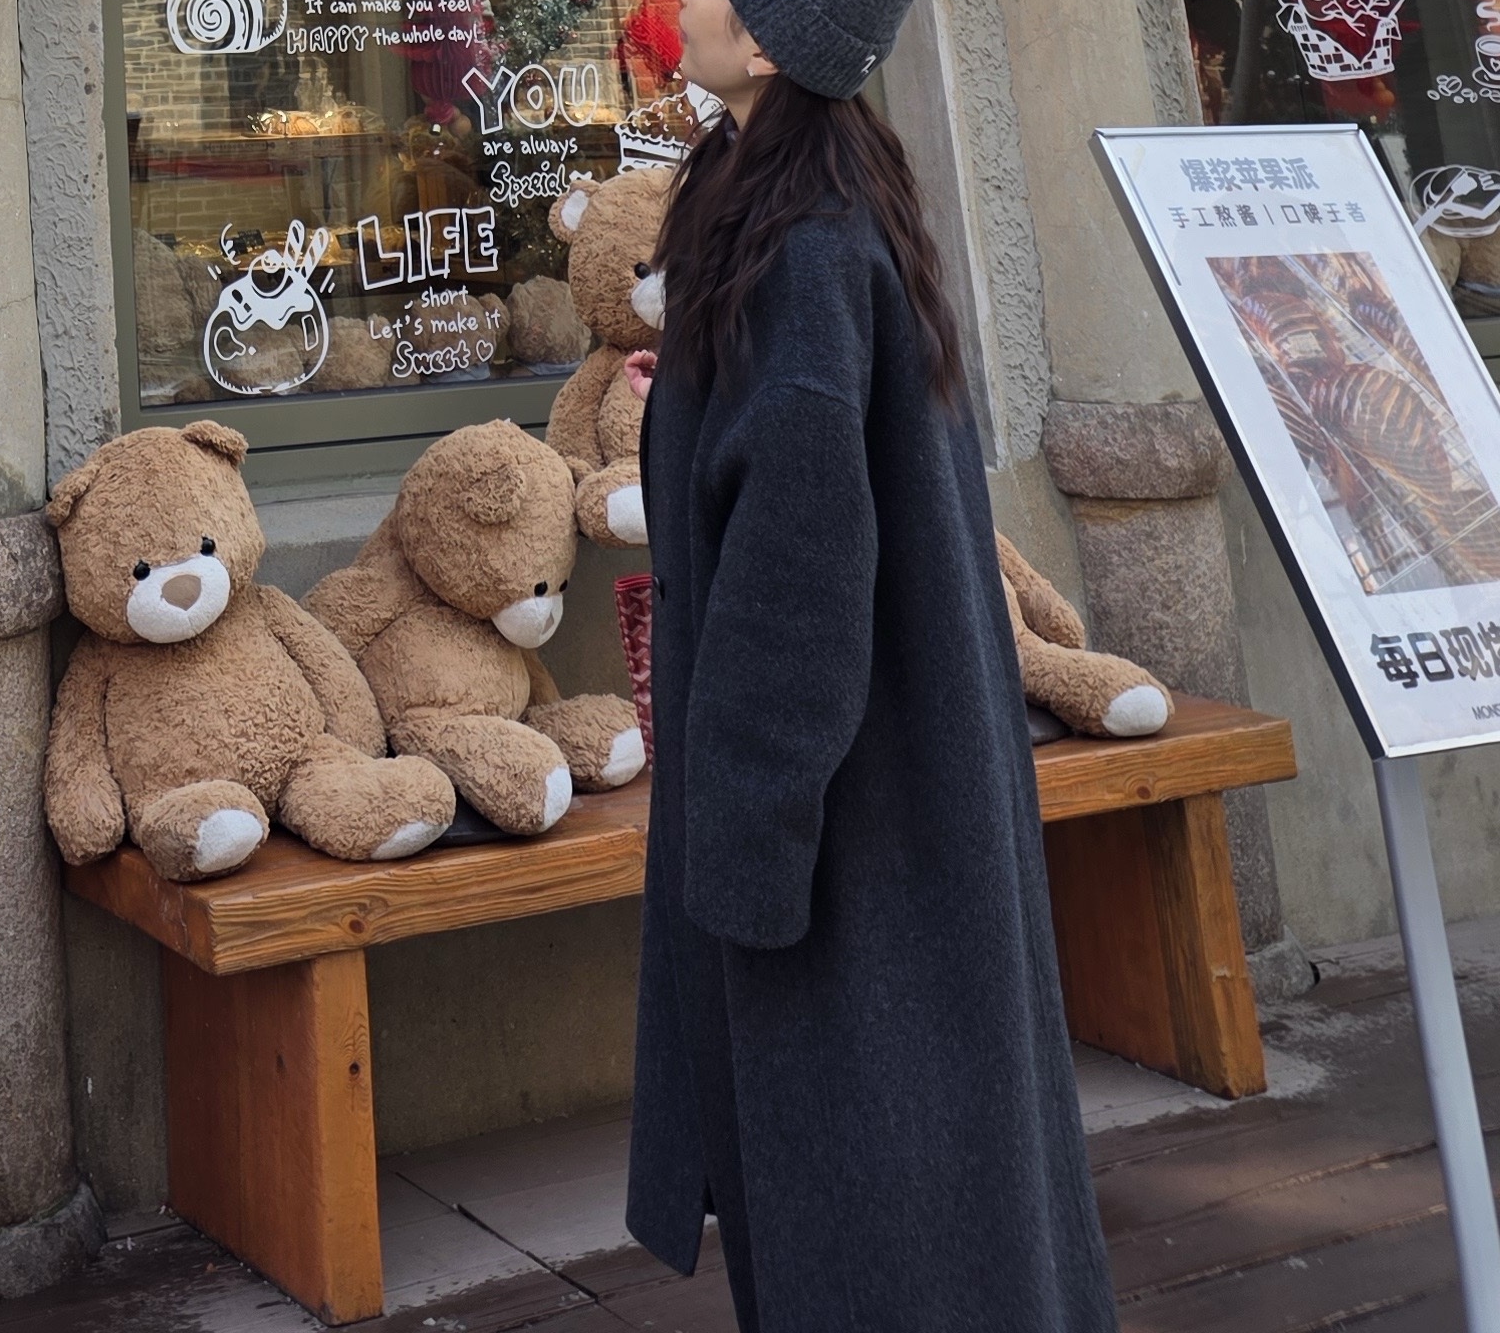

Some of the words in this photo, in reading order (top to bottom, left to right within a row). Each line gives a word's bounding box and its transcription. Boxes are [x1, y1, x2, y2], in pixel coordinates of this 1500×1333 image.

[330, 0, 357, 14] can
[406, 1, 434, 20] you
[287, 24, 370, 55] HAPPY
[372, 26, 400, 45] the
[403, 23, 445, 43] whole
[448, 23, 482, 49] day!
[461, 64, 600, 135] YOU
[483, 140, 514, 157] are
[520, 135, 579, 162] always
[1180, 157, 1320, 193] 爆浆苹果派
[358, 206, 499, 291] LIFE
[421, 284, 469, 309] short
[430, 313, 479, 336] make
[484, 309, 502, 331] it
[392, 341, 472, 379] Sweet
